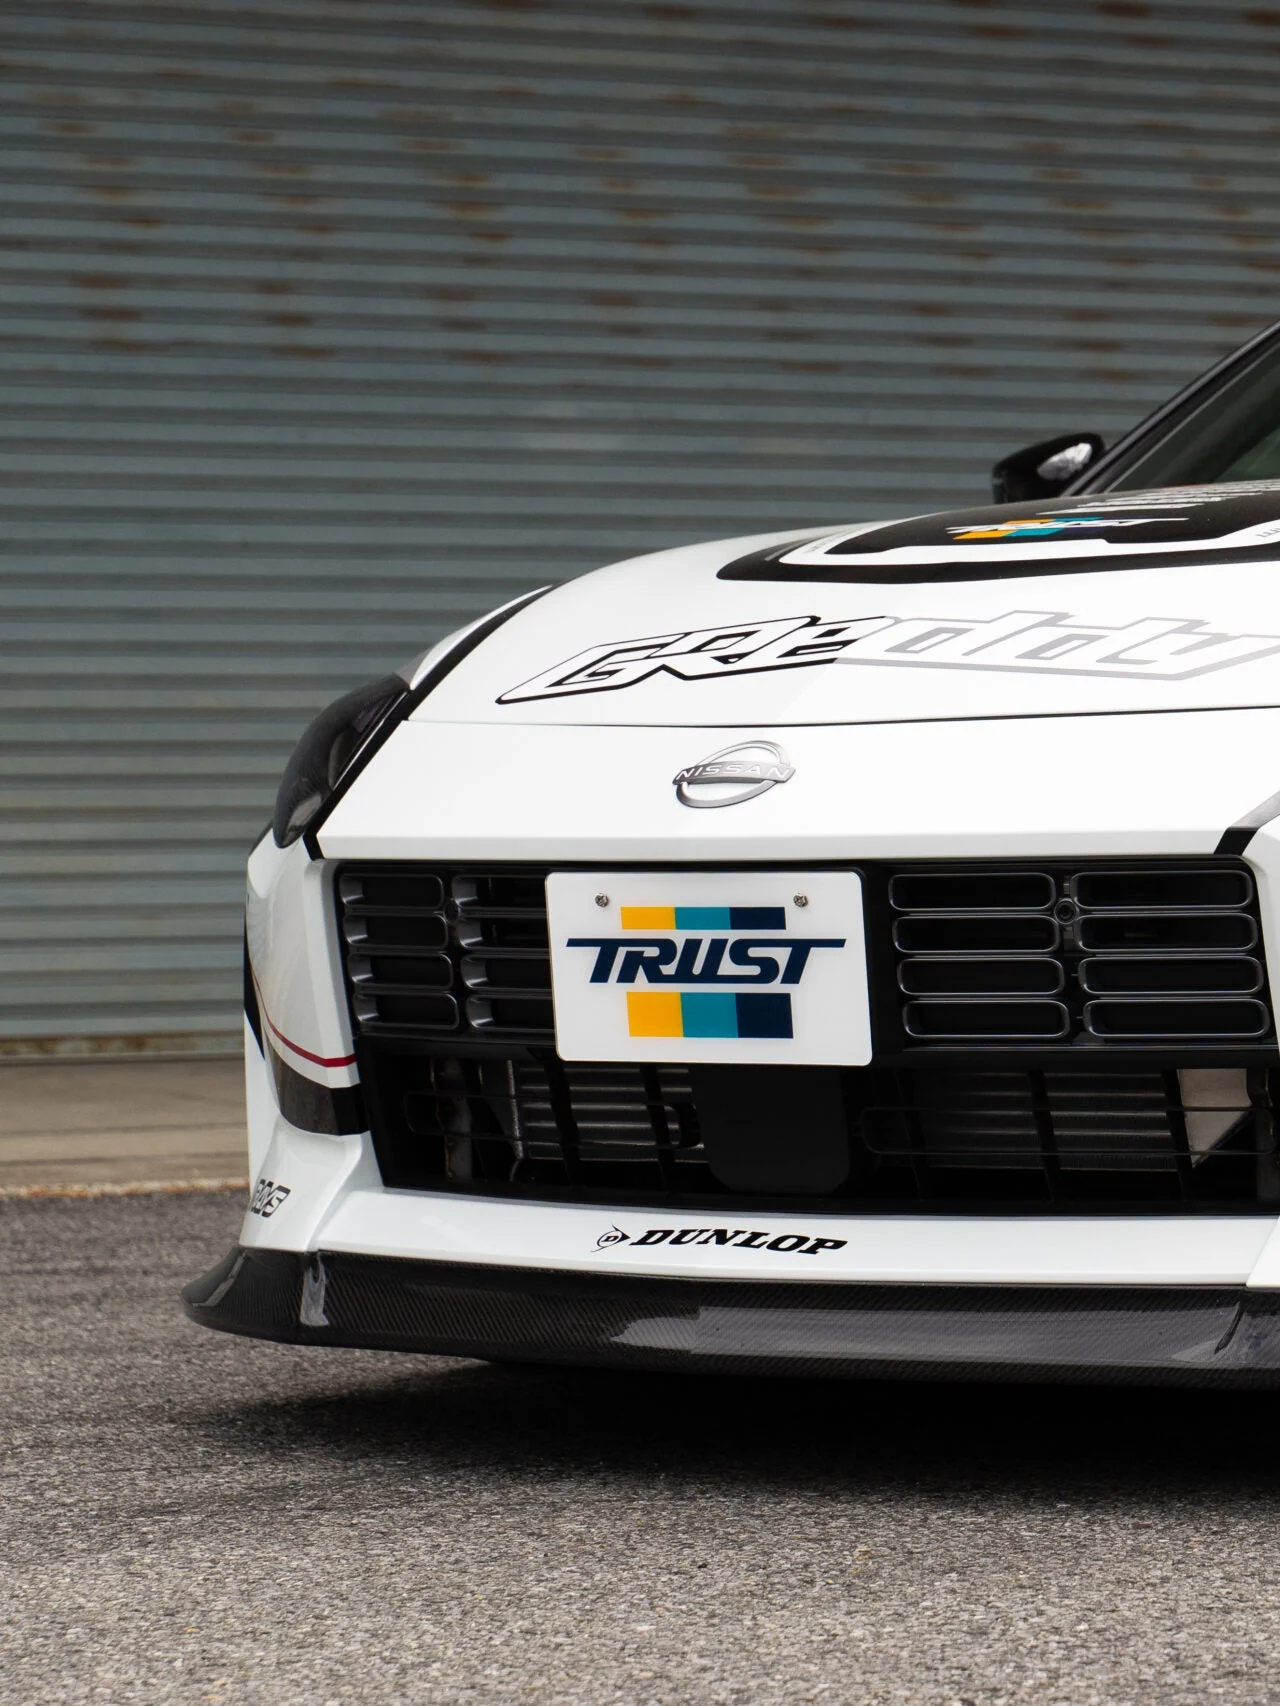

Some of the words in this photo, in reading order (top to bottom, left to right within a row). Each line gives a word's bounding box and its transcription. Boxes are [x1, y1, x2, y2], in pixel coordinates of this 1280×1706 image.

[676, 763, 789, 780] NISSAN
[566, 938, 847, 985] TRUST
[629, 1229, 848, 1255] DUNLOP
